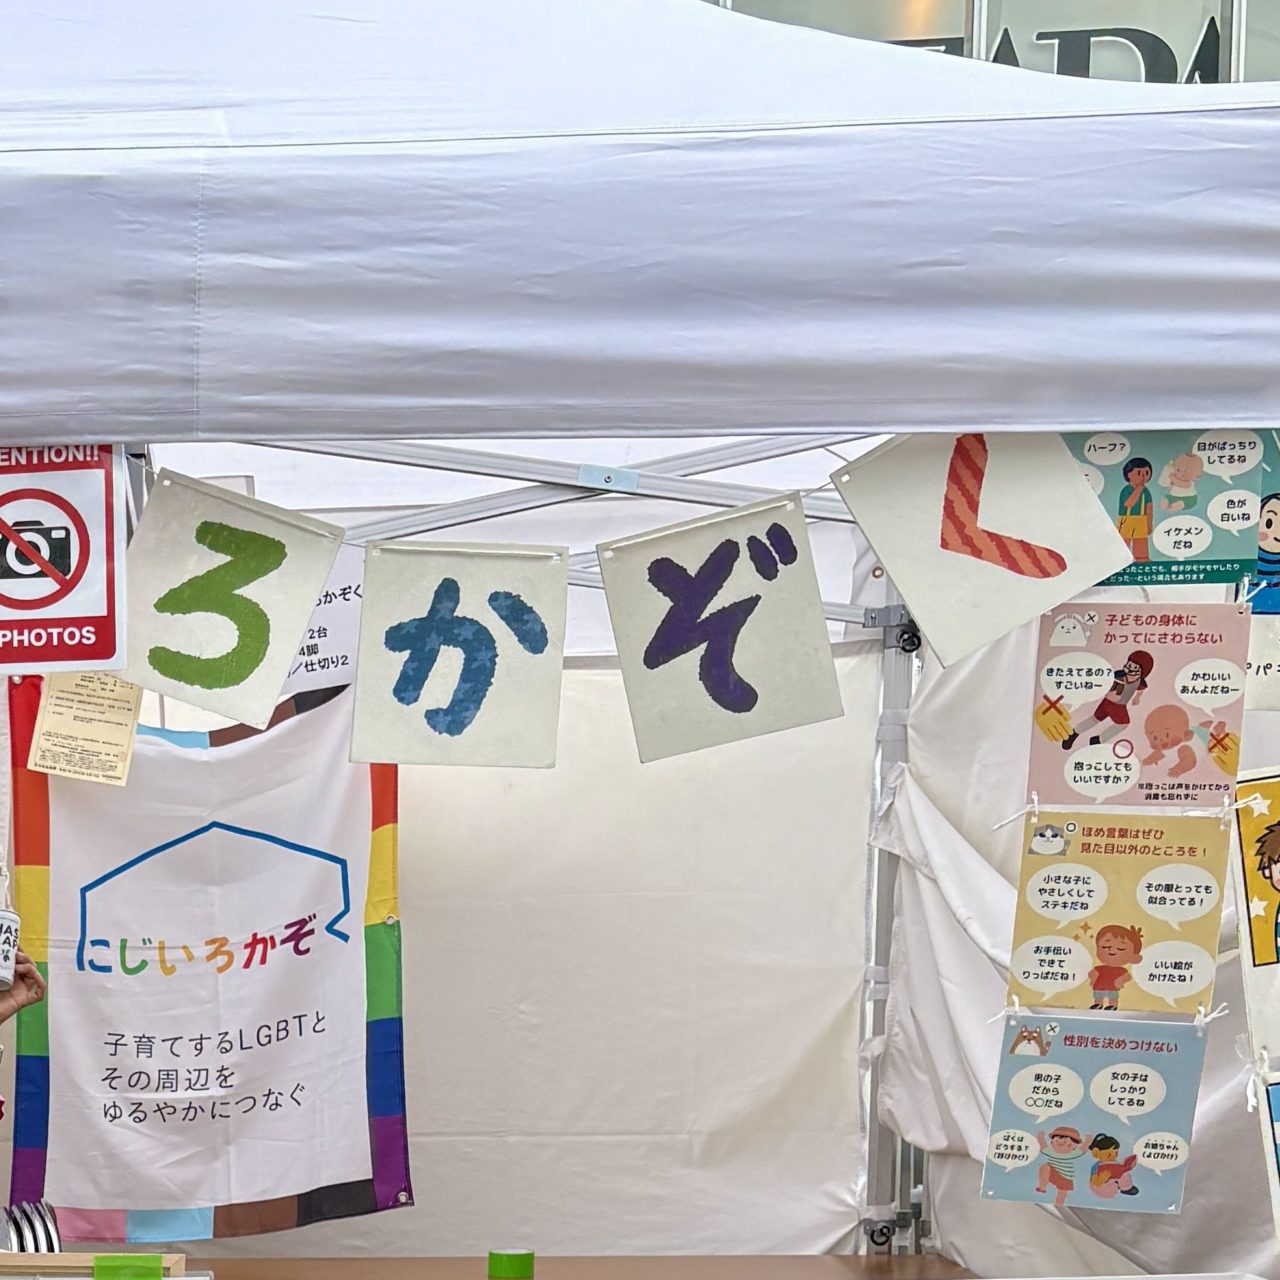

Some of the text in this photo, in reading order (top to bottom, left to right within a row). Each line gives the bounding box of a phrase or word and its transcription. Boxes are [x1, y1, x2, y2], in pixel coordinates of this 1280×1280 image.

[1087, 441, 1126, 454] ハーフ？
[1207, 453, 1247, 464] してるね
[1226, 498, 1247, 510] 色が
[1221, 511, 1251, 523] 白いね
[1163, 527, 1203, 538] イケメン
[1173, 539, 1193, 550] だね
[147, 520, 288, 690] ろ
[642, 521, 798, 714] ぞ
[1105, 613, 1197, 627] 子どもの身体に
[308, 626, 328, 639] 2台
[1104, 632, 1223, 645] かってにさわらない
[384, 577, 548, 737] か
[287, 655, 349, 678] ／仕切り2
[1045, 667, 1112, 678] きたえてるの？
[1191, 671, 1231, 682] かわいい
[1180, 685, 1240, 697] あんよだねー
[1074, 762, 1132, 773] 抱っこしても
[1073, 774, 1131, 785] いいですか？
[1082, 827, 1164, 841] ほめ言葉はぜひ
[1080, 843, 1207, 858] 見た目以外のところを！
[1043, 875, 1092, 886] 小さな子に
[1038, 888, 1095, 899] やさしくして
[1041, 900, 1089, 911] ステキだね
[1148, 895, 1205, 907] 似合ってる！
[75, 912, 351, 978] にじいろかぞく
[1033, 945, 1072, 957] お手伝い
[1038, 958, 1066, 969] できて
[1154, 960, 1193, 971] いい絵が
[1022, 970, 1077, 982] りっぱだね！
[1148, 973, 1194, 985] かけたね！
[103, 1011, 327, 1060] 子育てするLGBTと
[1063, 1034, 1178, 1053] 性別を決めつけない
[100, 1065, 236, 1094] その周辺を
[1034, 1072, 1062, 1084] 男の子
[1110, 1071, 1148, 1083] 女の子は
[1031, 1085, 1060, 1096] だから
[1109, 1084, 1146, 1095] しっかり
[102, 1082, 306, 1125] ゆるやかにつなぐ
[1107, 1096, 1145, 1108] してるね
